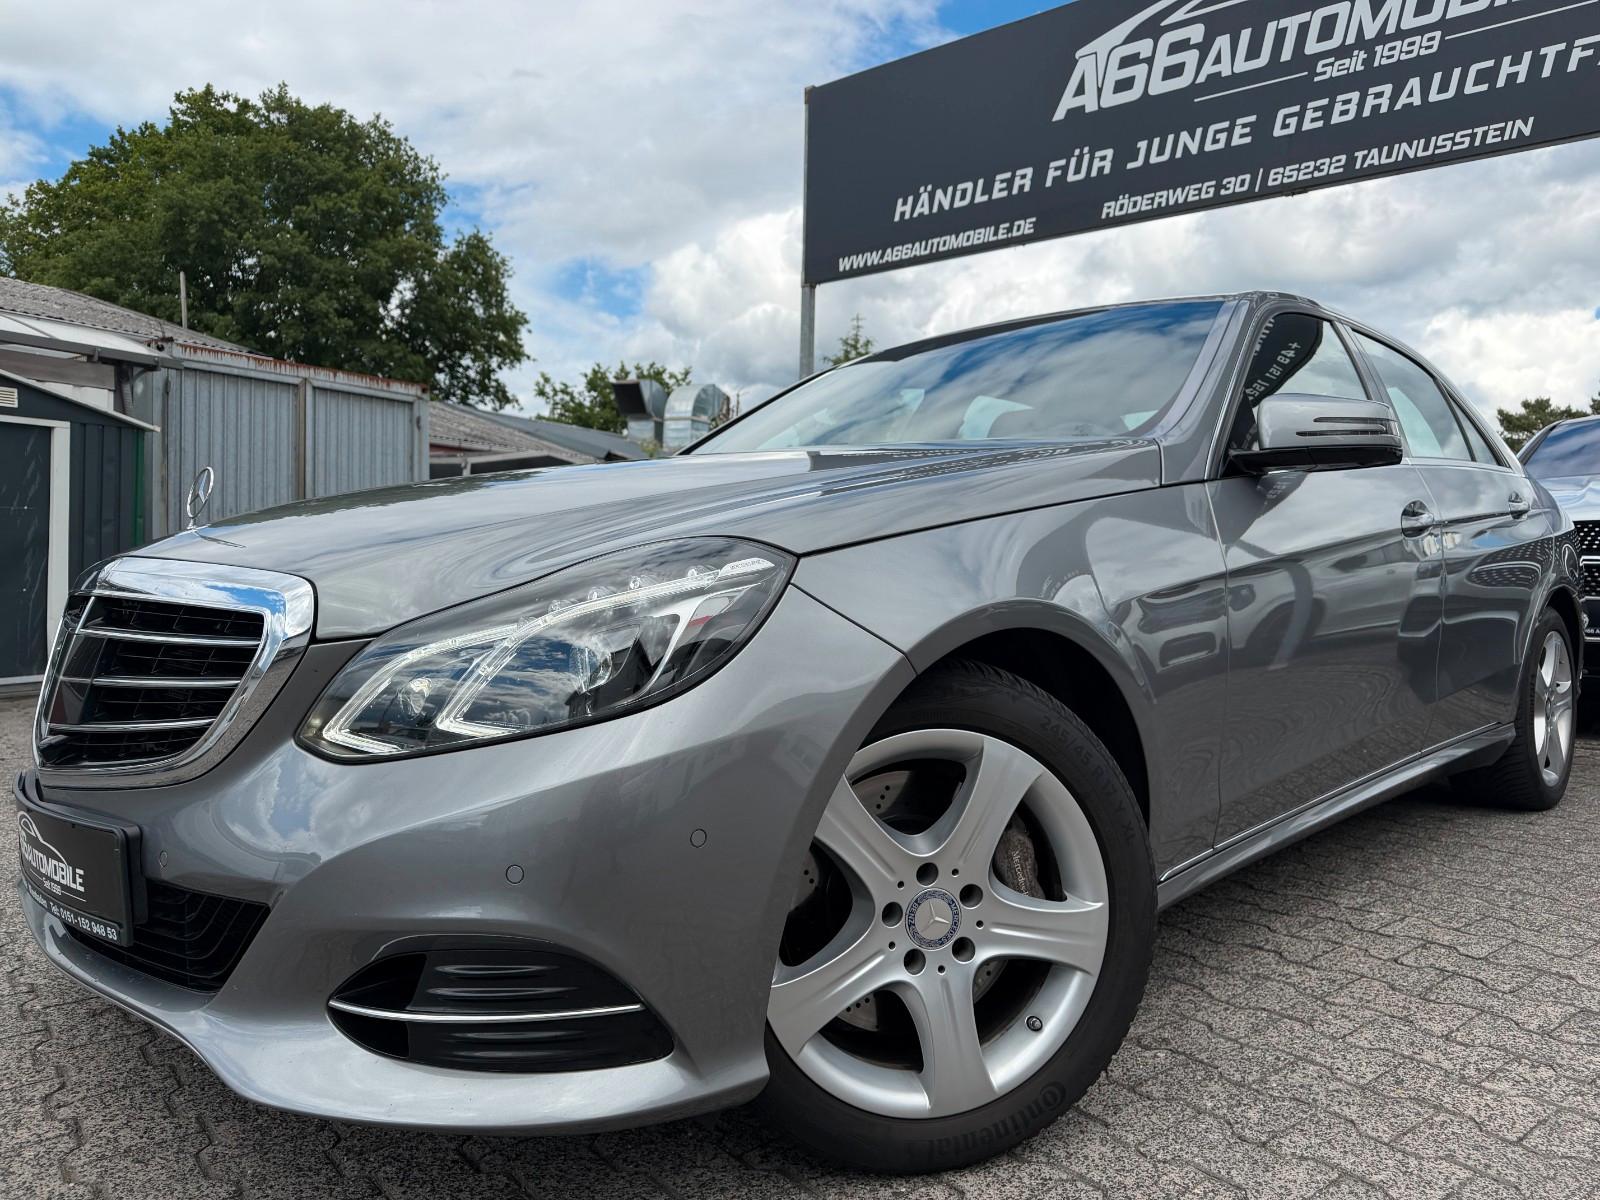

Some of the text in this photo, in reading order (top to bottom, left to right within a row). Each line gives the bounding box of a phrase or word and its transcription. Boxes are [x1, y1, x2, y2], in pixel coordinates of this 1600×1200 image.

[1313, 30, 1442, 82] Seit 1999
[893, 34, 1600, 222] HÄNDLER FÜR JUNGE GEBRAUCHTF
[1101, 181, 1217, 219] RÖDERWEG
[1219, 174, 1251, 196] 30
[1267, 154, 1347, 187] 65232
[1354, 116, 1535, 170] TAUNUSSTEIN
[838, 217, 1036, 272] WWW.A66AUTOMOBILE.DE
[106, 926, 118, 941] 53
